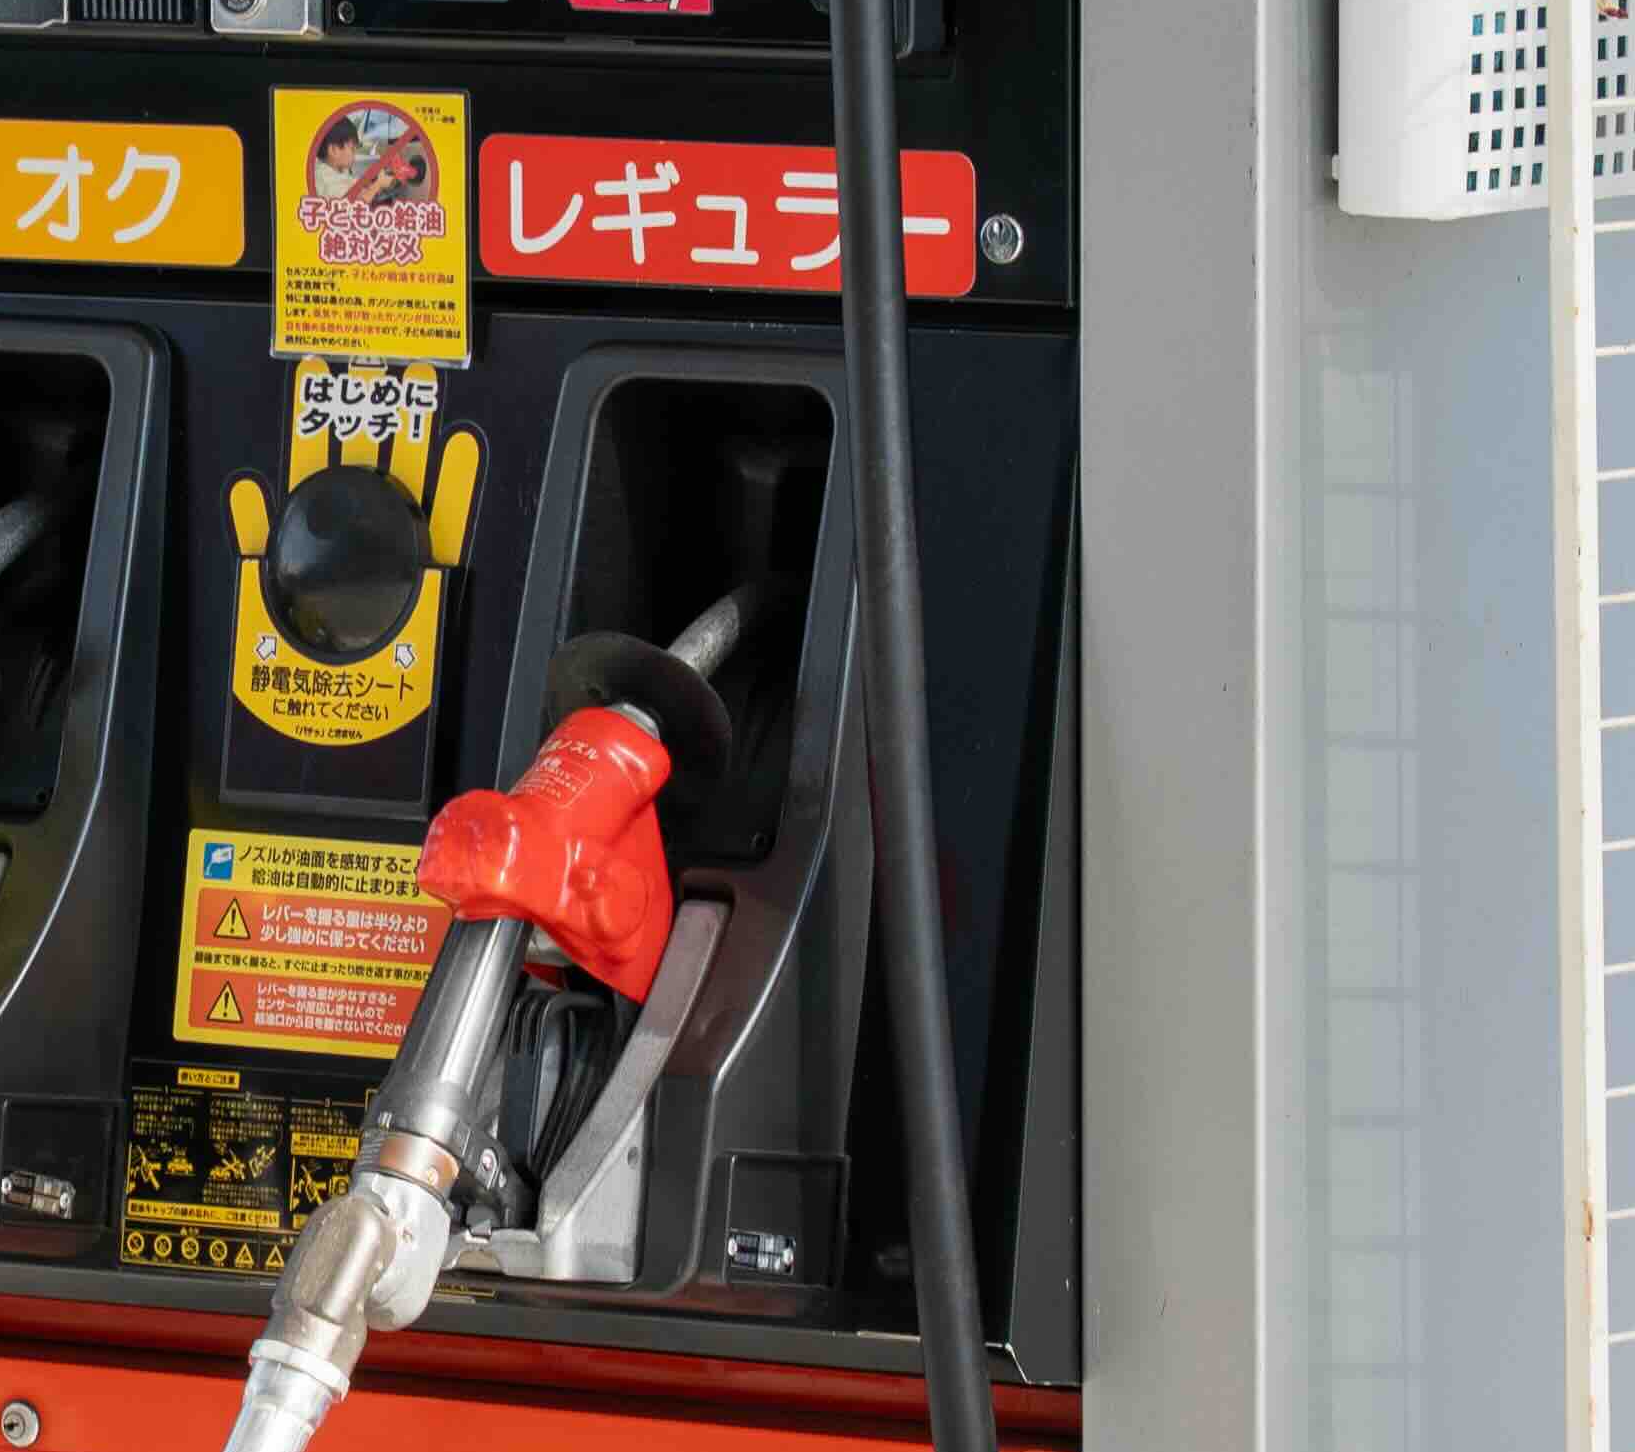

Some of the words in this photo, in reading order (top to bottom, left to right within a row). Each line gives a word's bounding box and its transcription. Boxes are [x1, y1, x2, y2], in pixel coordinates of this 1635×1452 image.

[301, 197, 443, 234] 子どもの給油
[510, 157, 951, 273] レギュラー
[322, 232, 422, 263] 絶対ダメ
[302, 376, 438, 409] はじめに
[299, 408, 425, 440] タッチ!
[250, 664, 415, 703] 静電気除去シート
[271, 697, 391, 723] に触れてください
[251, 868, 420, 898] 給油は自動的に止まります
